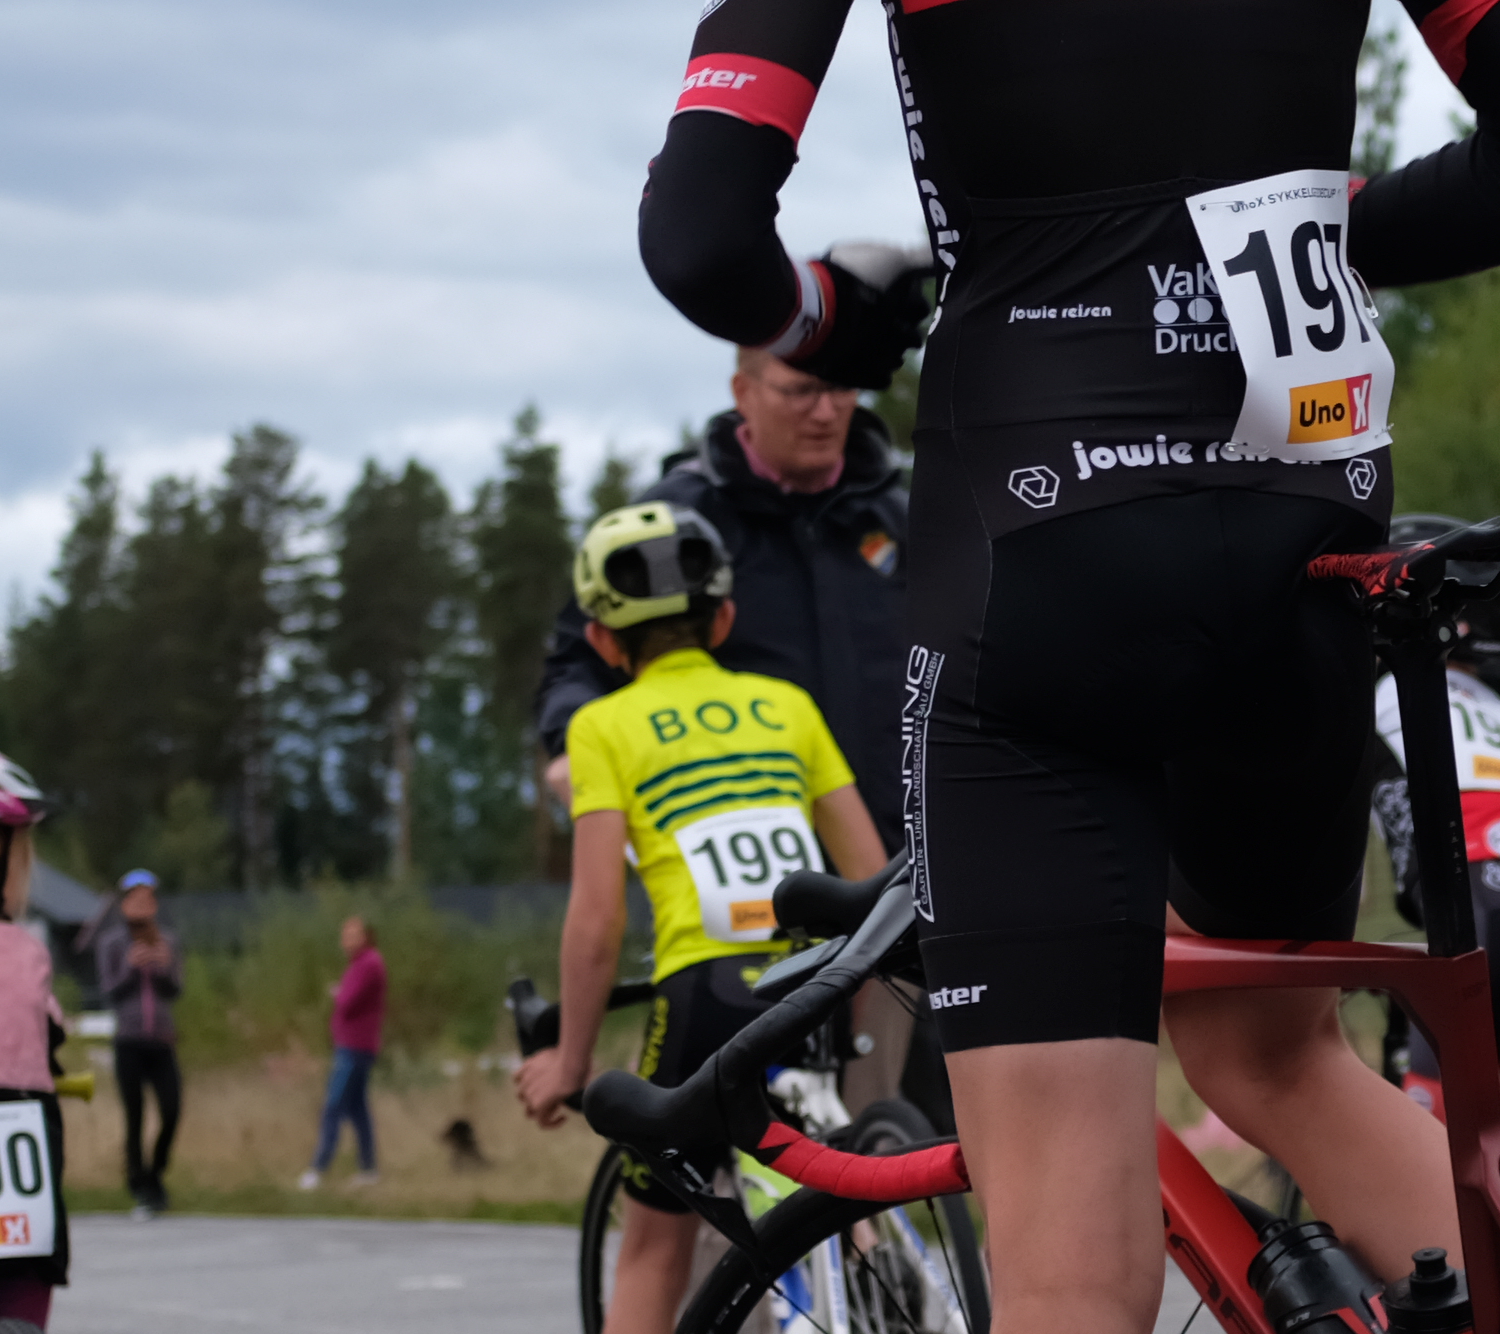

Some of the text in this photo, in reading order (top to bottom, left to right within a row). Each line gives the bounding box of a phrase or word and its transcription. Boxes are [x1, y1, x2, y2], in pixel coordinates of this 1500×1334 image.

[680, 67, 757, 93] ster
[1008, 303, 1113, 324] jowie reisen
[1299, 378, 1370, 431] Uno X
[1072, 433, 1194, 481] jowie
[649, 698, 786, 745] BOC
[690, 826, 813, 888] 199
[928, 983, 988, 1012] ster
